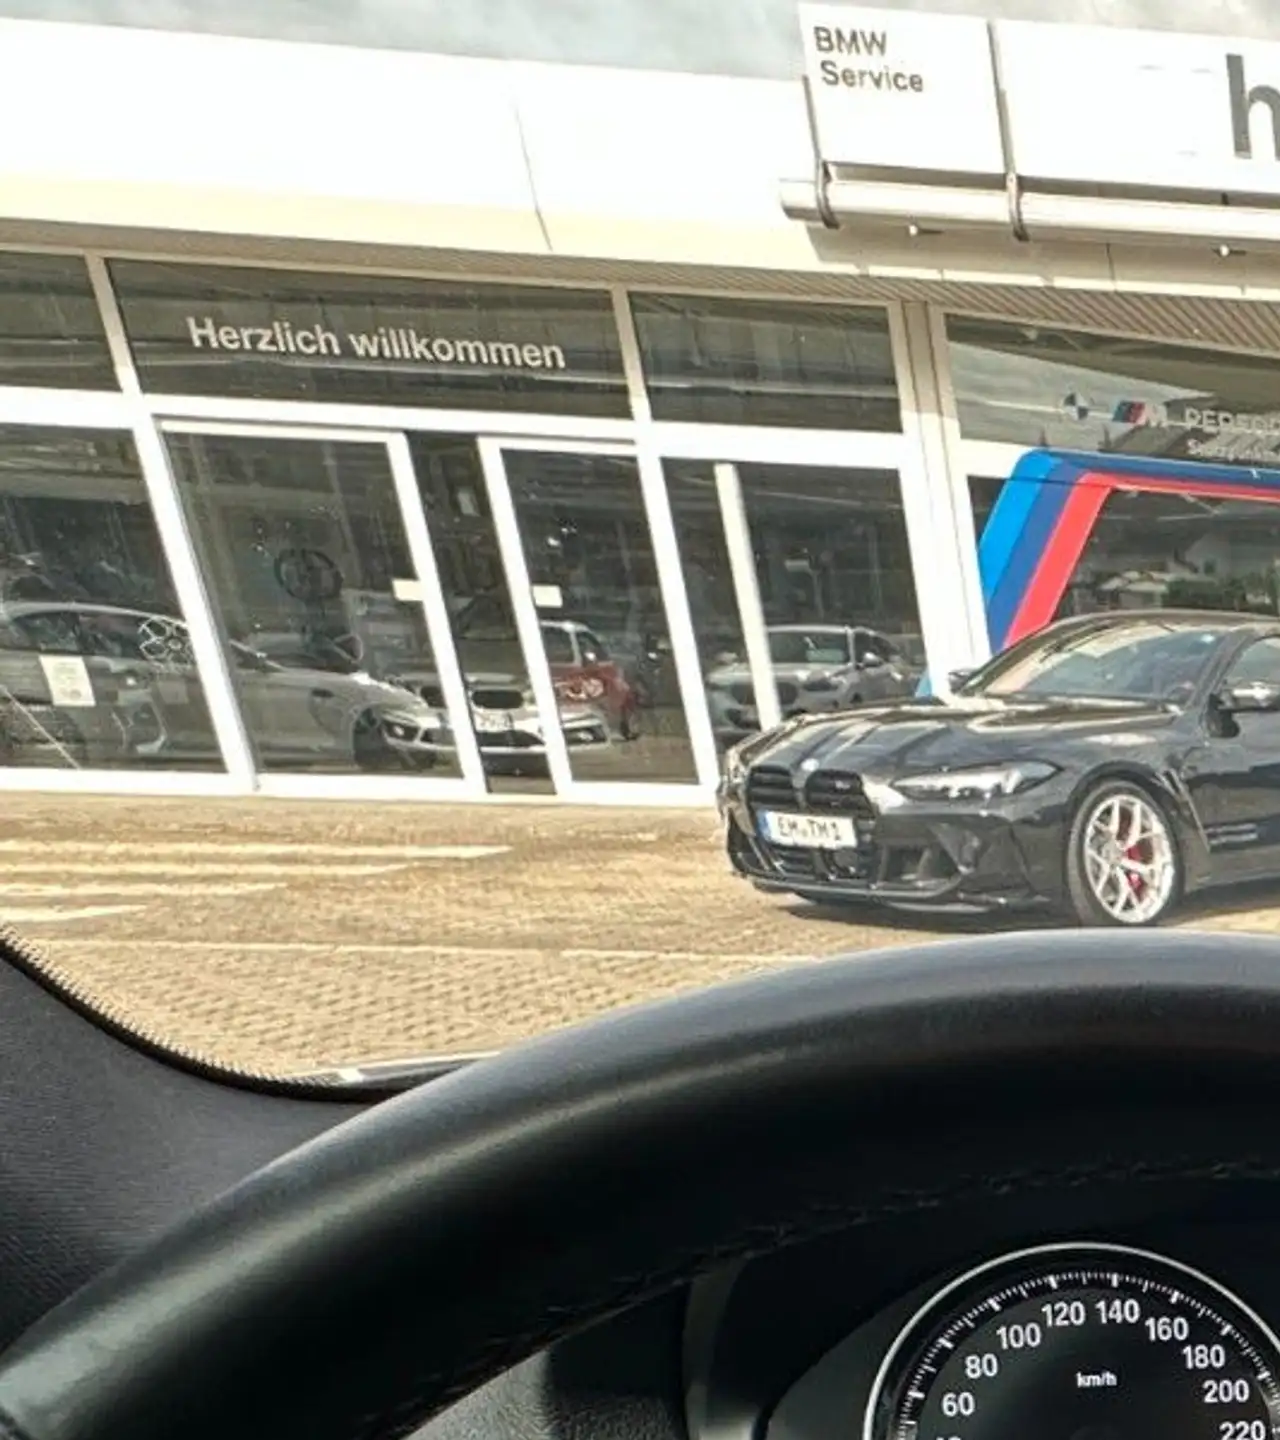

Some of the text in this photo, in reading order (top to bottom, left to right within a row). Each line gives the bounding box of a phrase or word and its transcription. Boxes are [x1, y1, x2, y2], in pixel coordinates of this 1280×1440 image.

[813, 26, 887, 55] BMW
[820, 60, 924, 92] Service
[186, 317, 566, 369] Herzlich willkommen
[1041, 1301, 1085, 1327] 120
[1095, 1299, 1140, 1324] 140
[996, 1322, 1042, 1350] 100
[1145, 1317, 1189, 1341] 160
[965, 1353, 998, 1379] 80
[1182, 1344, 1225, 1370] 180
[1076, 1371, 1117, 1388] km/h
[1203, 1379, 1249, 1404] 200
[942, 1392, 975, 1417] 60
